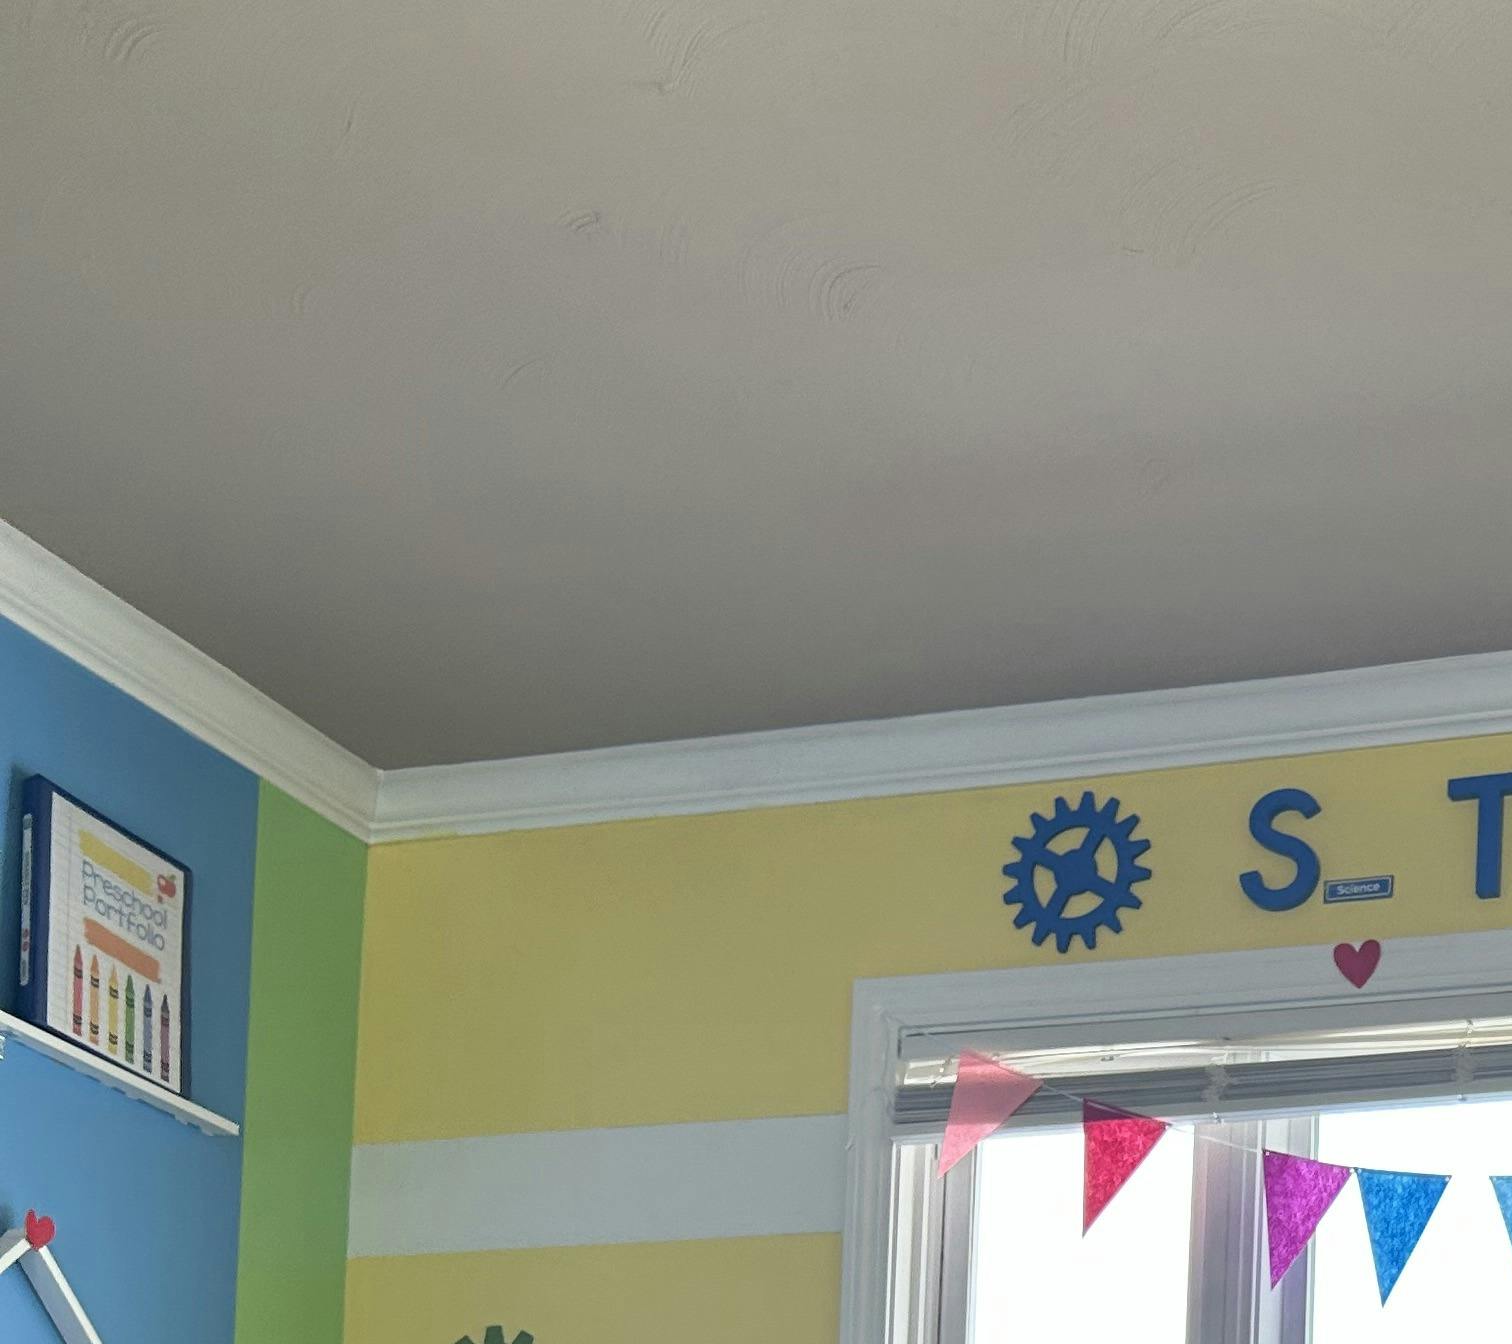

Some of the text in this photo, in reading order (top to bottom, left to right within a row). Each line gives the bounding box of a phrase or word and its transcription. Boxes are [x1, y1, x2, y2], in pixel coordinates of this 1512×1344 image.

[82, 859, 168, 930] Preschool
[83, 884, 166, 951] Portfolio
[1336, 882, 1381, 896] Science
